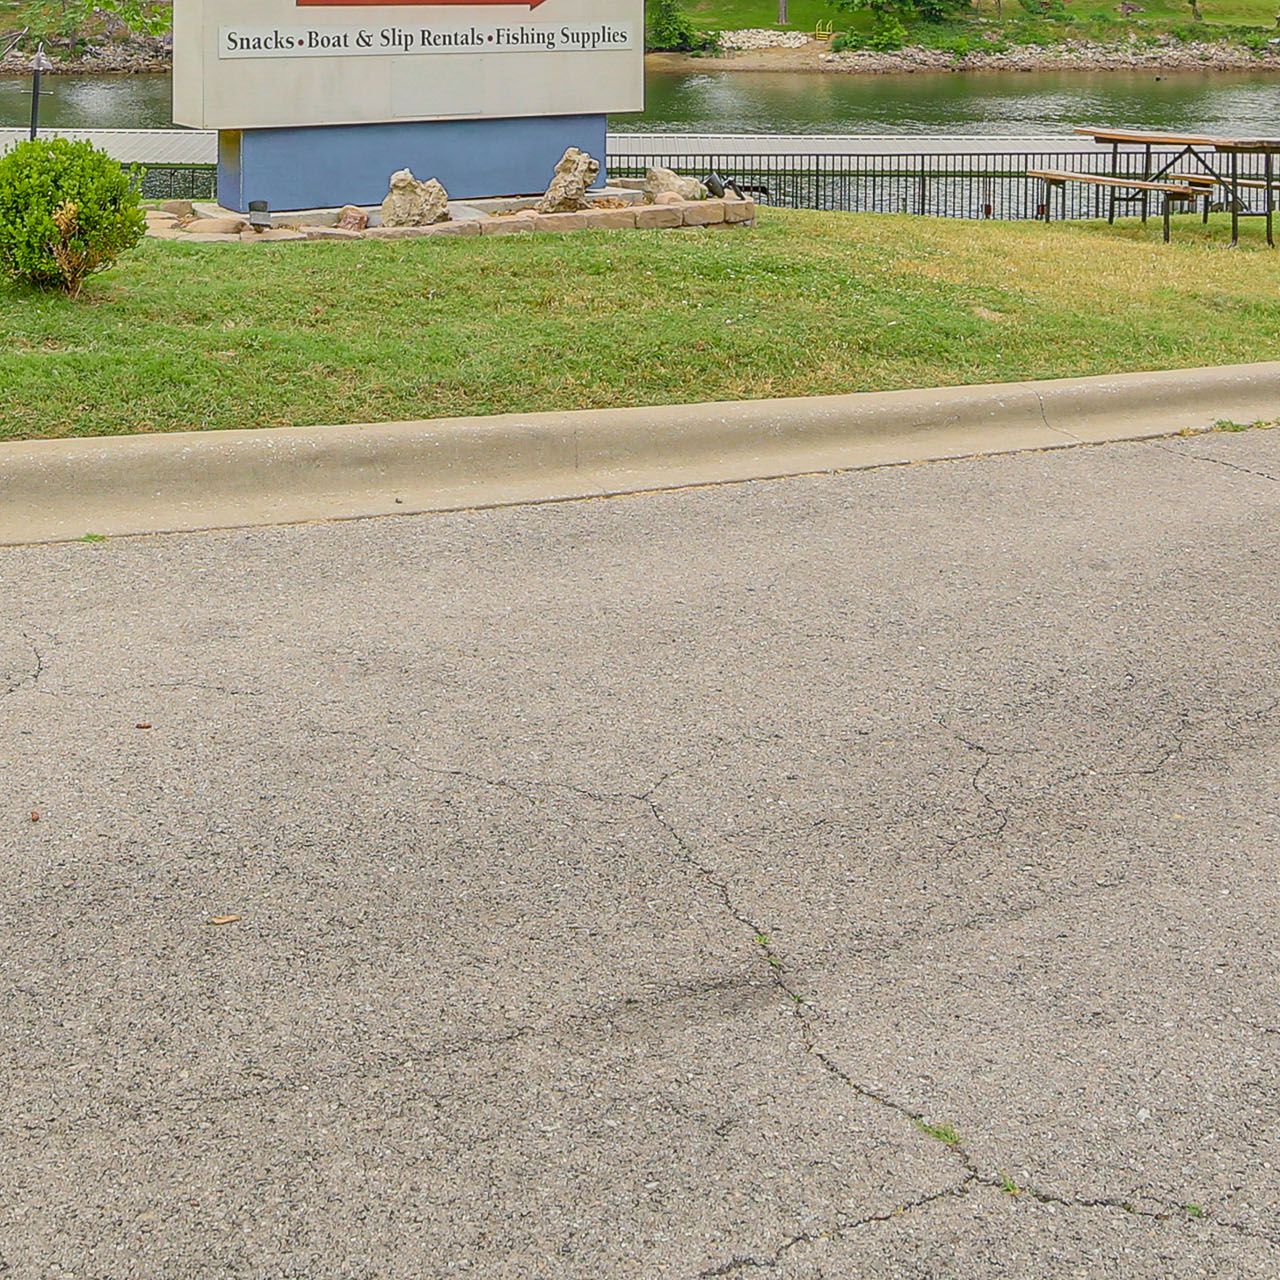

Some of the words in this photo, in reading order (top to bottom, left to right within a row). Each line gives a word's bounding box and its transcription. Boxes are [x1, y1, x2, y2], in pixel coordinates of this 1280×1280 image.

[227, 30, 295, 50] Snacks
[307, 31, 350, 48] Boat
[356, 30, 373, 47] &
[380, 28, 414, 52] Slip
[420, 27, 484, 47] Rentals
[495, 26, 556, 49] Fishing
[560, 25, 628, 49] Supplies
